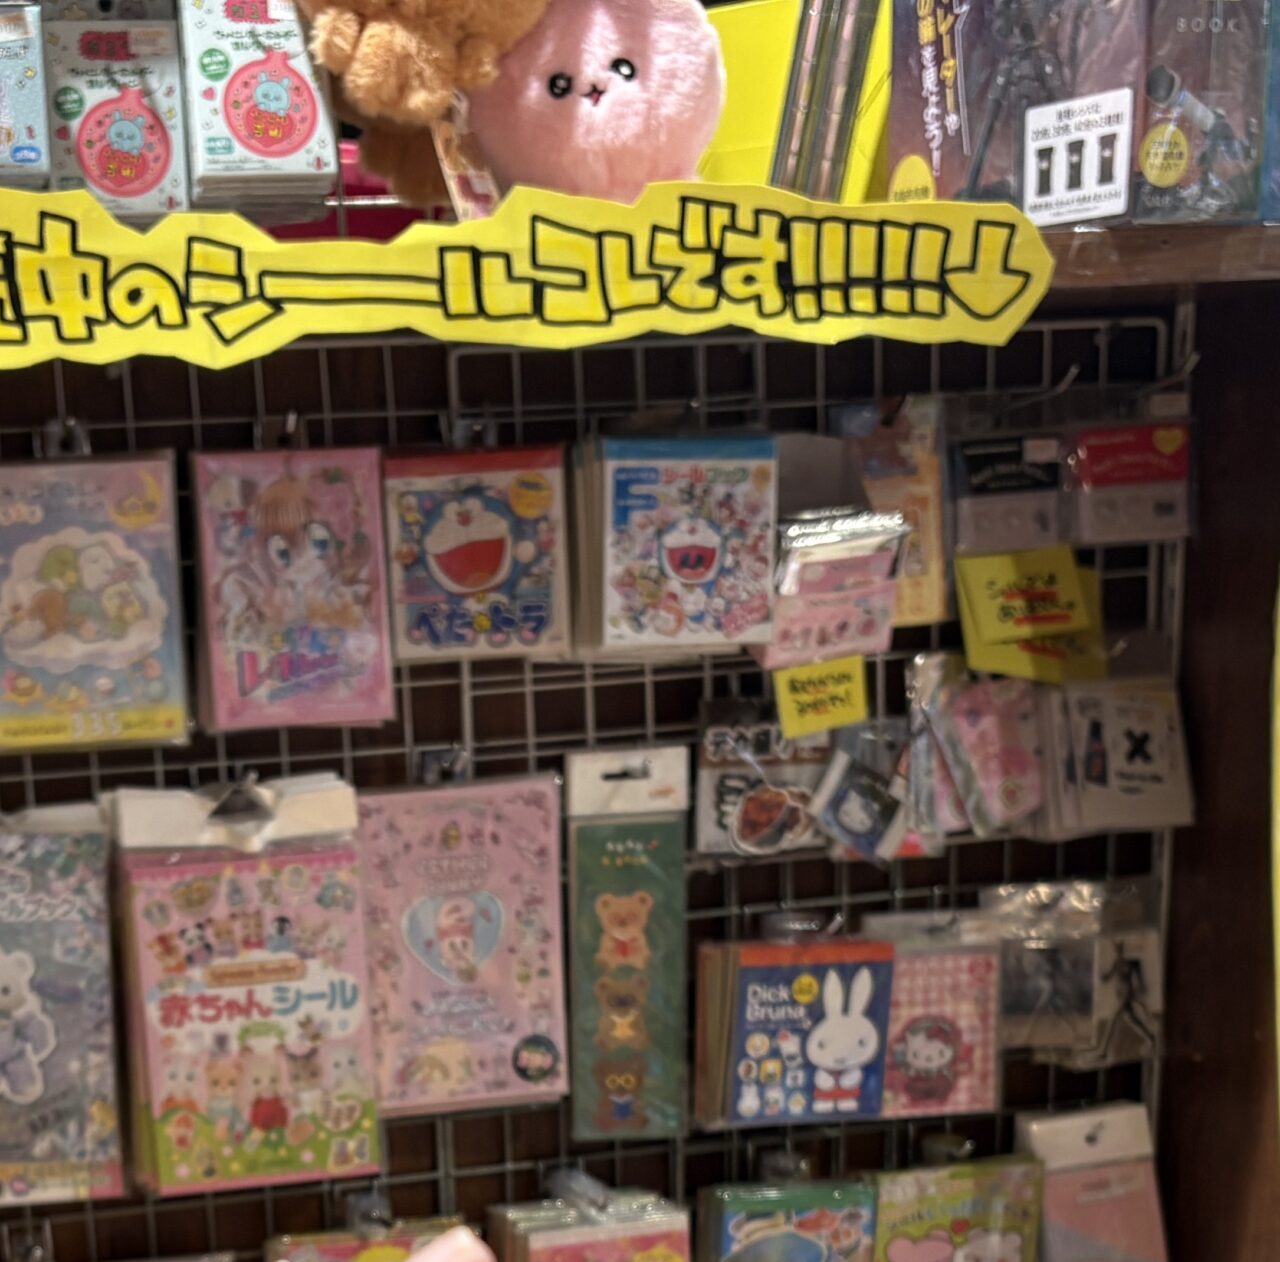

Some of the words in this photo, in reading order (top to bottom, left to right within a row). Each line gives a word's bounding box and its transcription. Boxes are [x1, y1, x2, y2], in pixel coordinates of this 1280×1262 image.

[71, 711, 121, 737] 335
[159, 978, 358, 1028] 赤ちゃんシール
[746, 983, 790, 1003] Dick
[745, 1003, 809, 1023] Bruna
